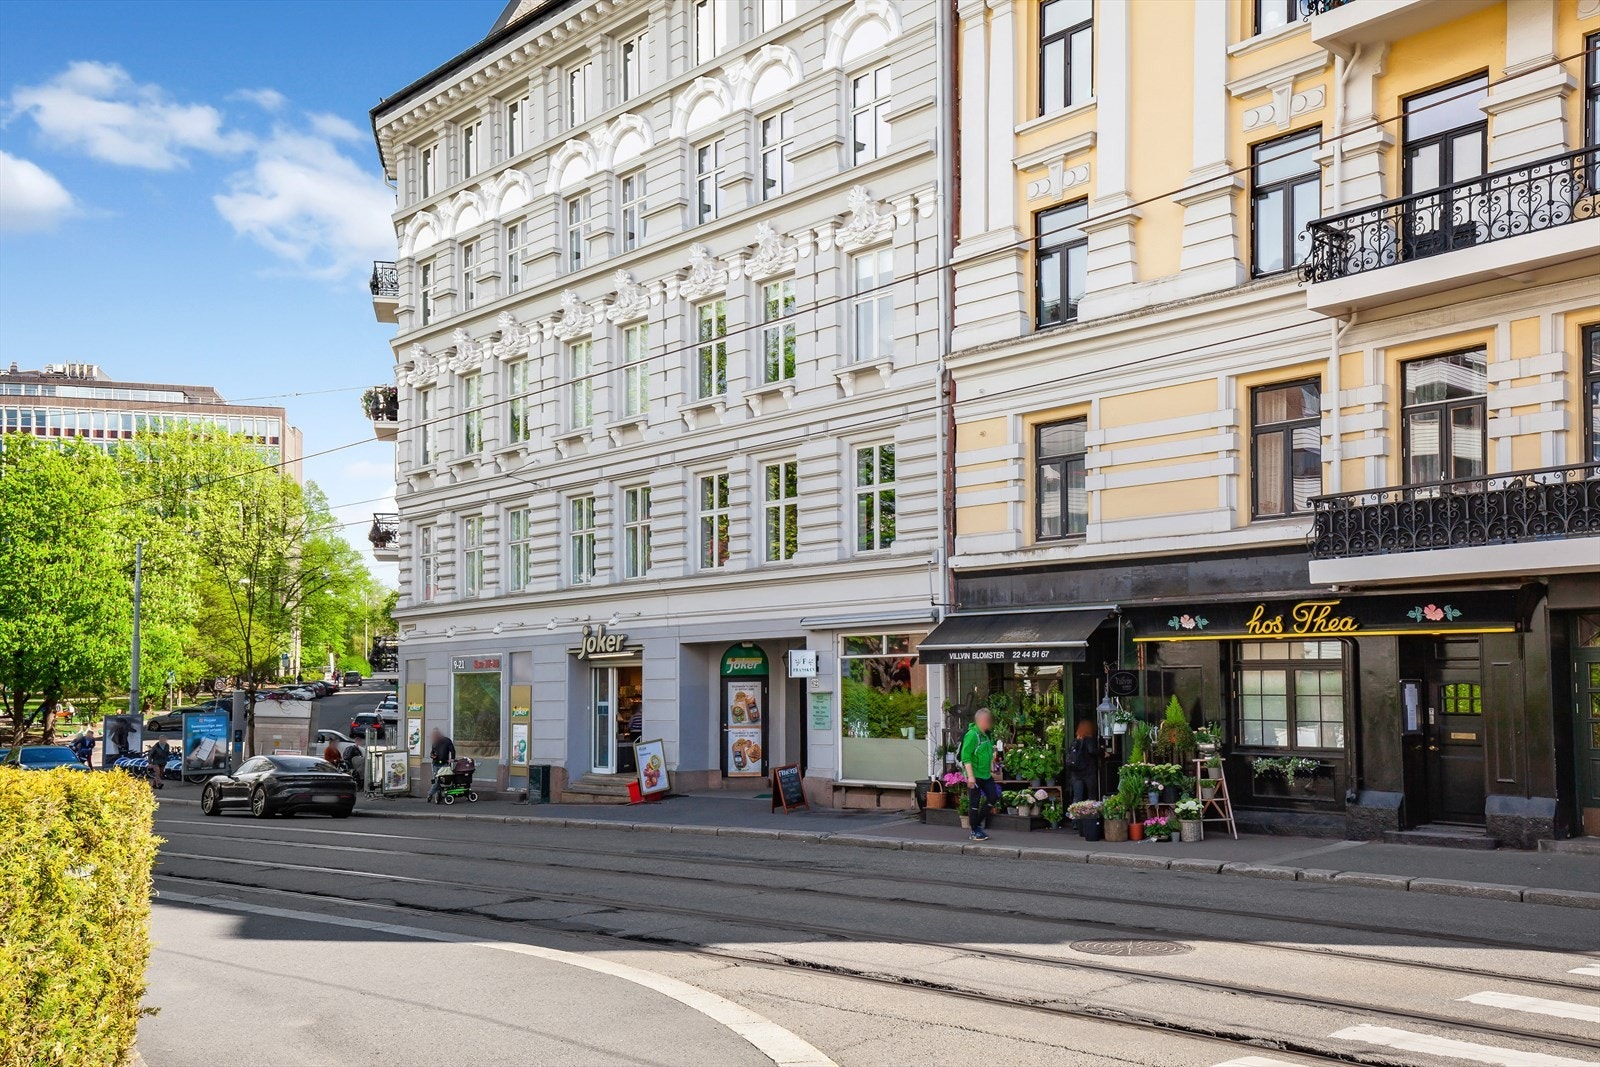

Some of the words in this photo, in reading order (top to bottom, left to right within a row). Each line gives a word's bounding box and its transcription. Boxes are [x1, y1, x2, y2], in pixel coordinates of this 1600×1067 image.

[1246, 604, 1283, 634] hos
[1292, 600, 1358, 634] Thea
[577, 624, 626, 660] joker
[949, 652, 971, 660] VILLVIN
[972, 651, 1005, 660] BLOMSTER
[1012, 651, 1021, 659] 22
[1022, 651, 1031, 659] 44
[1032, 650, 1040, 659] 91
[453, 660, 465, 669] 9-21
[727, 657, 759, 674] joker
